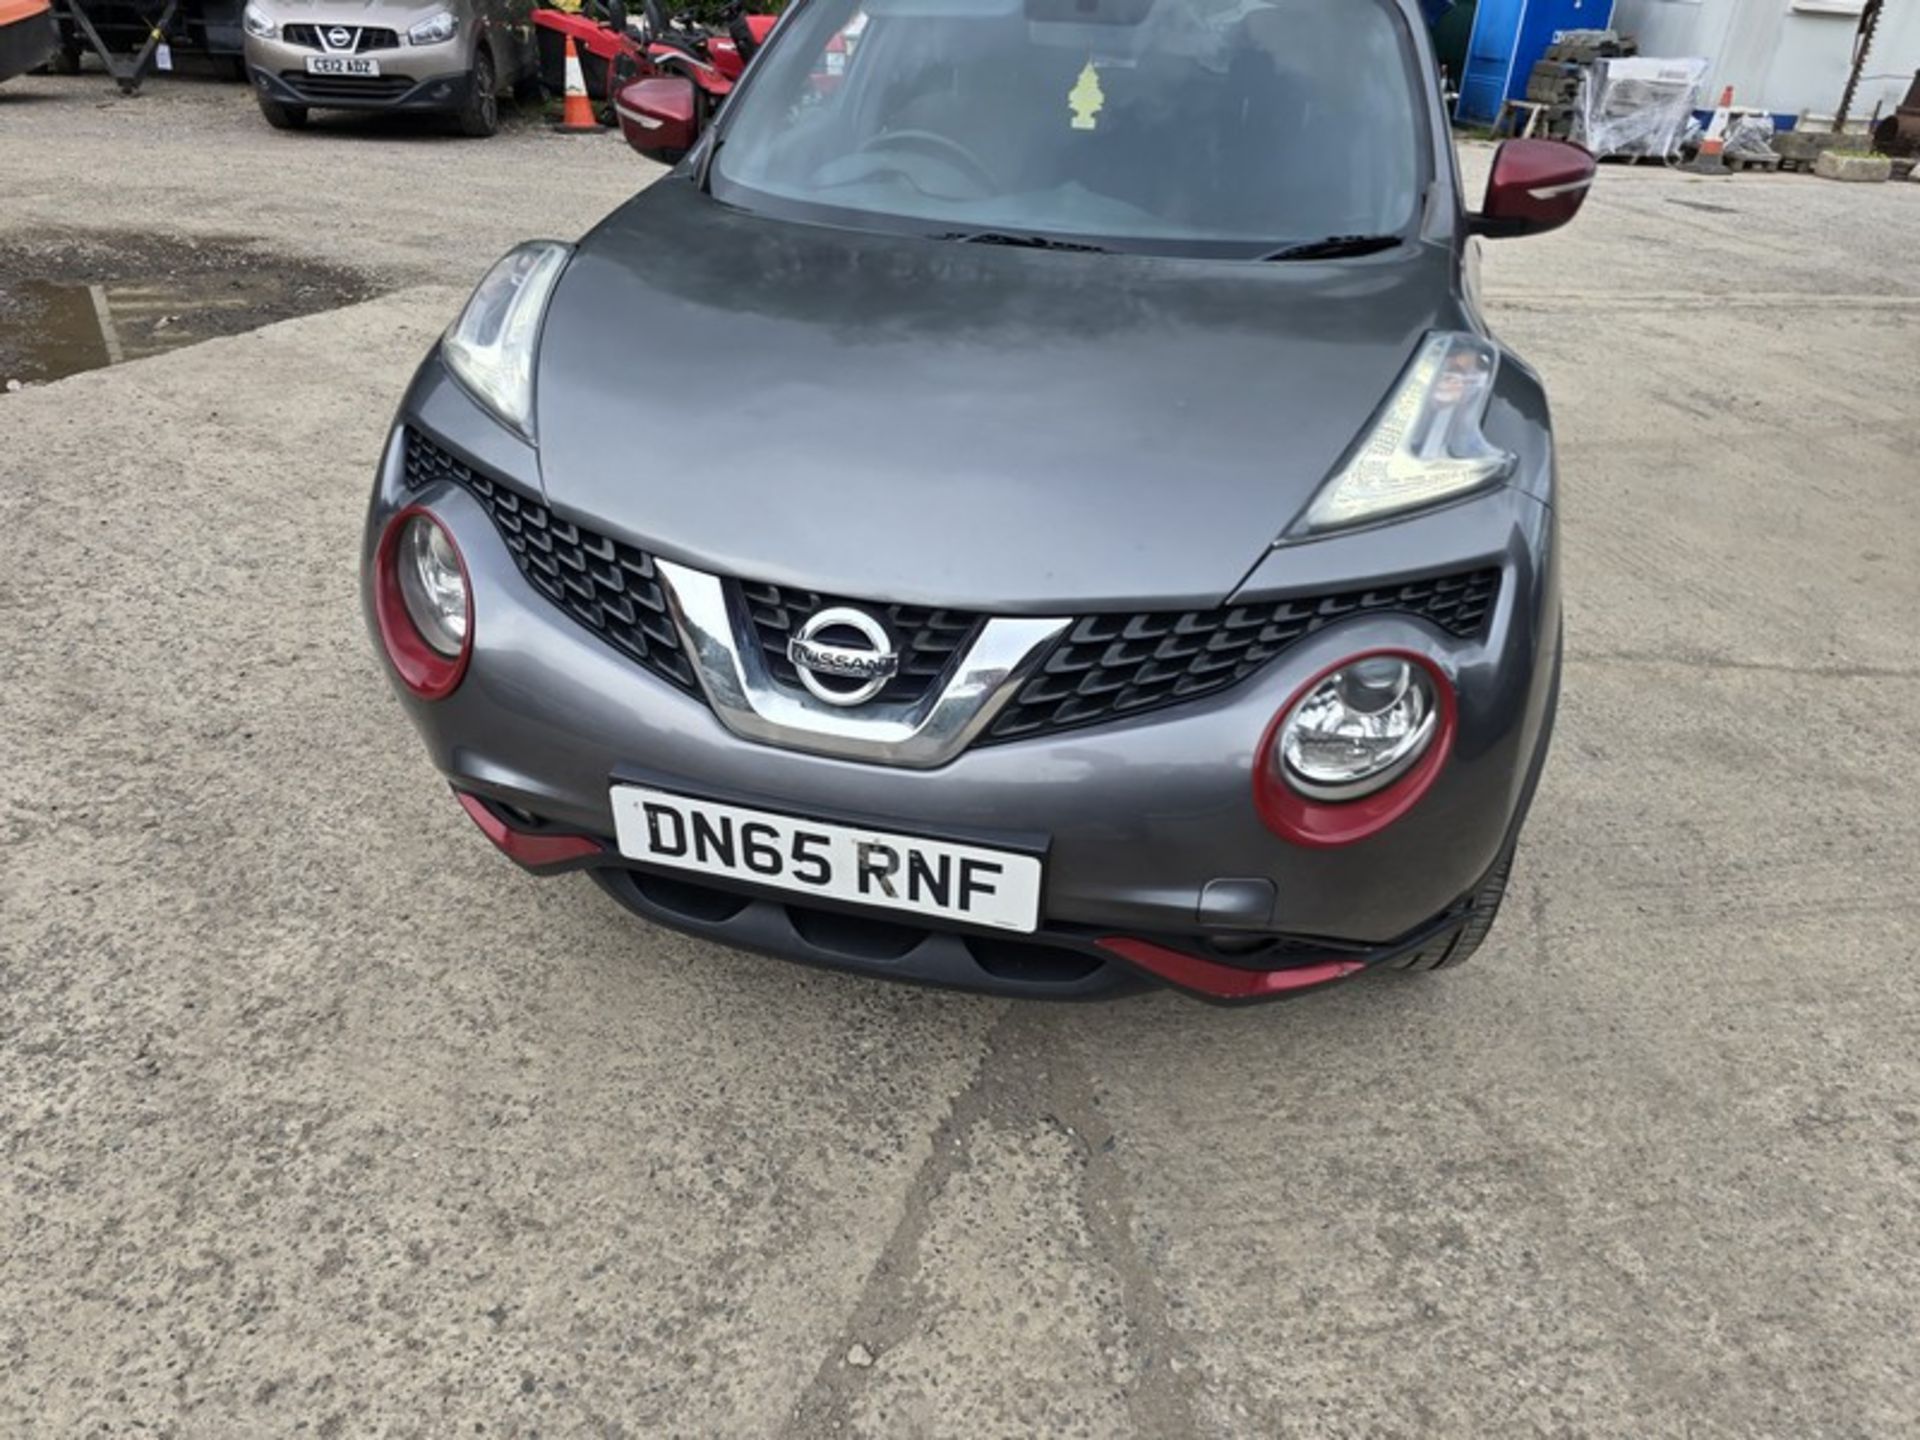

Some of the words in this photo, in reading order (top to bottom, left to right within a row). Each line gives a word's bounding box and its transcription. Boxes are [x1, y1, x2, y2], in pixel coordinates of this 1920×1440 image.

[314, 59, 343, 73] CE12
[793, 643, 889, 677] NISSAN
[642, 801, 832, 886] DN65
[856, 841, 1004, 912] RNF
